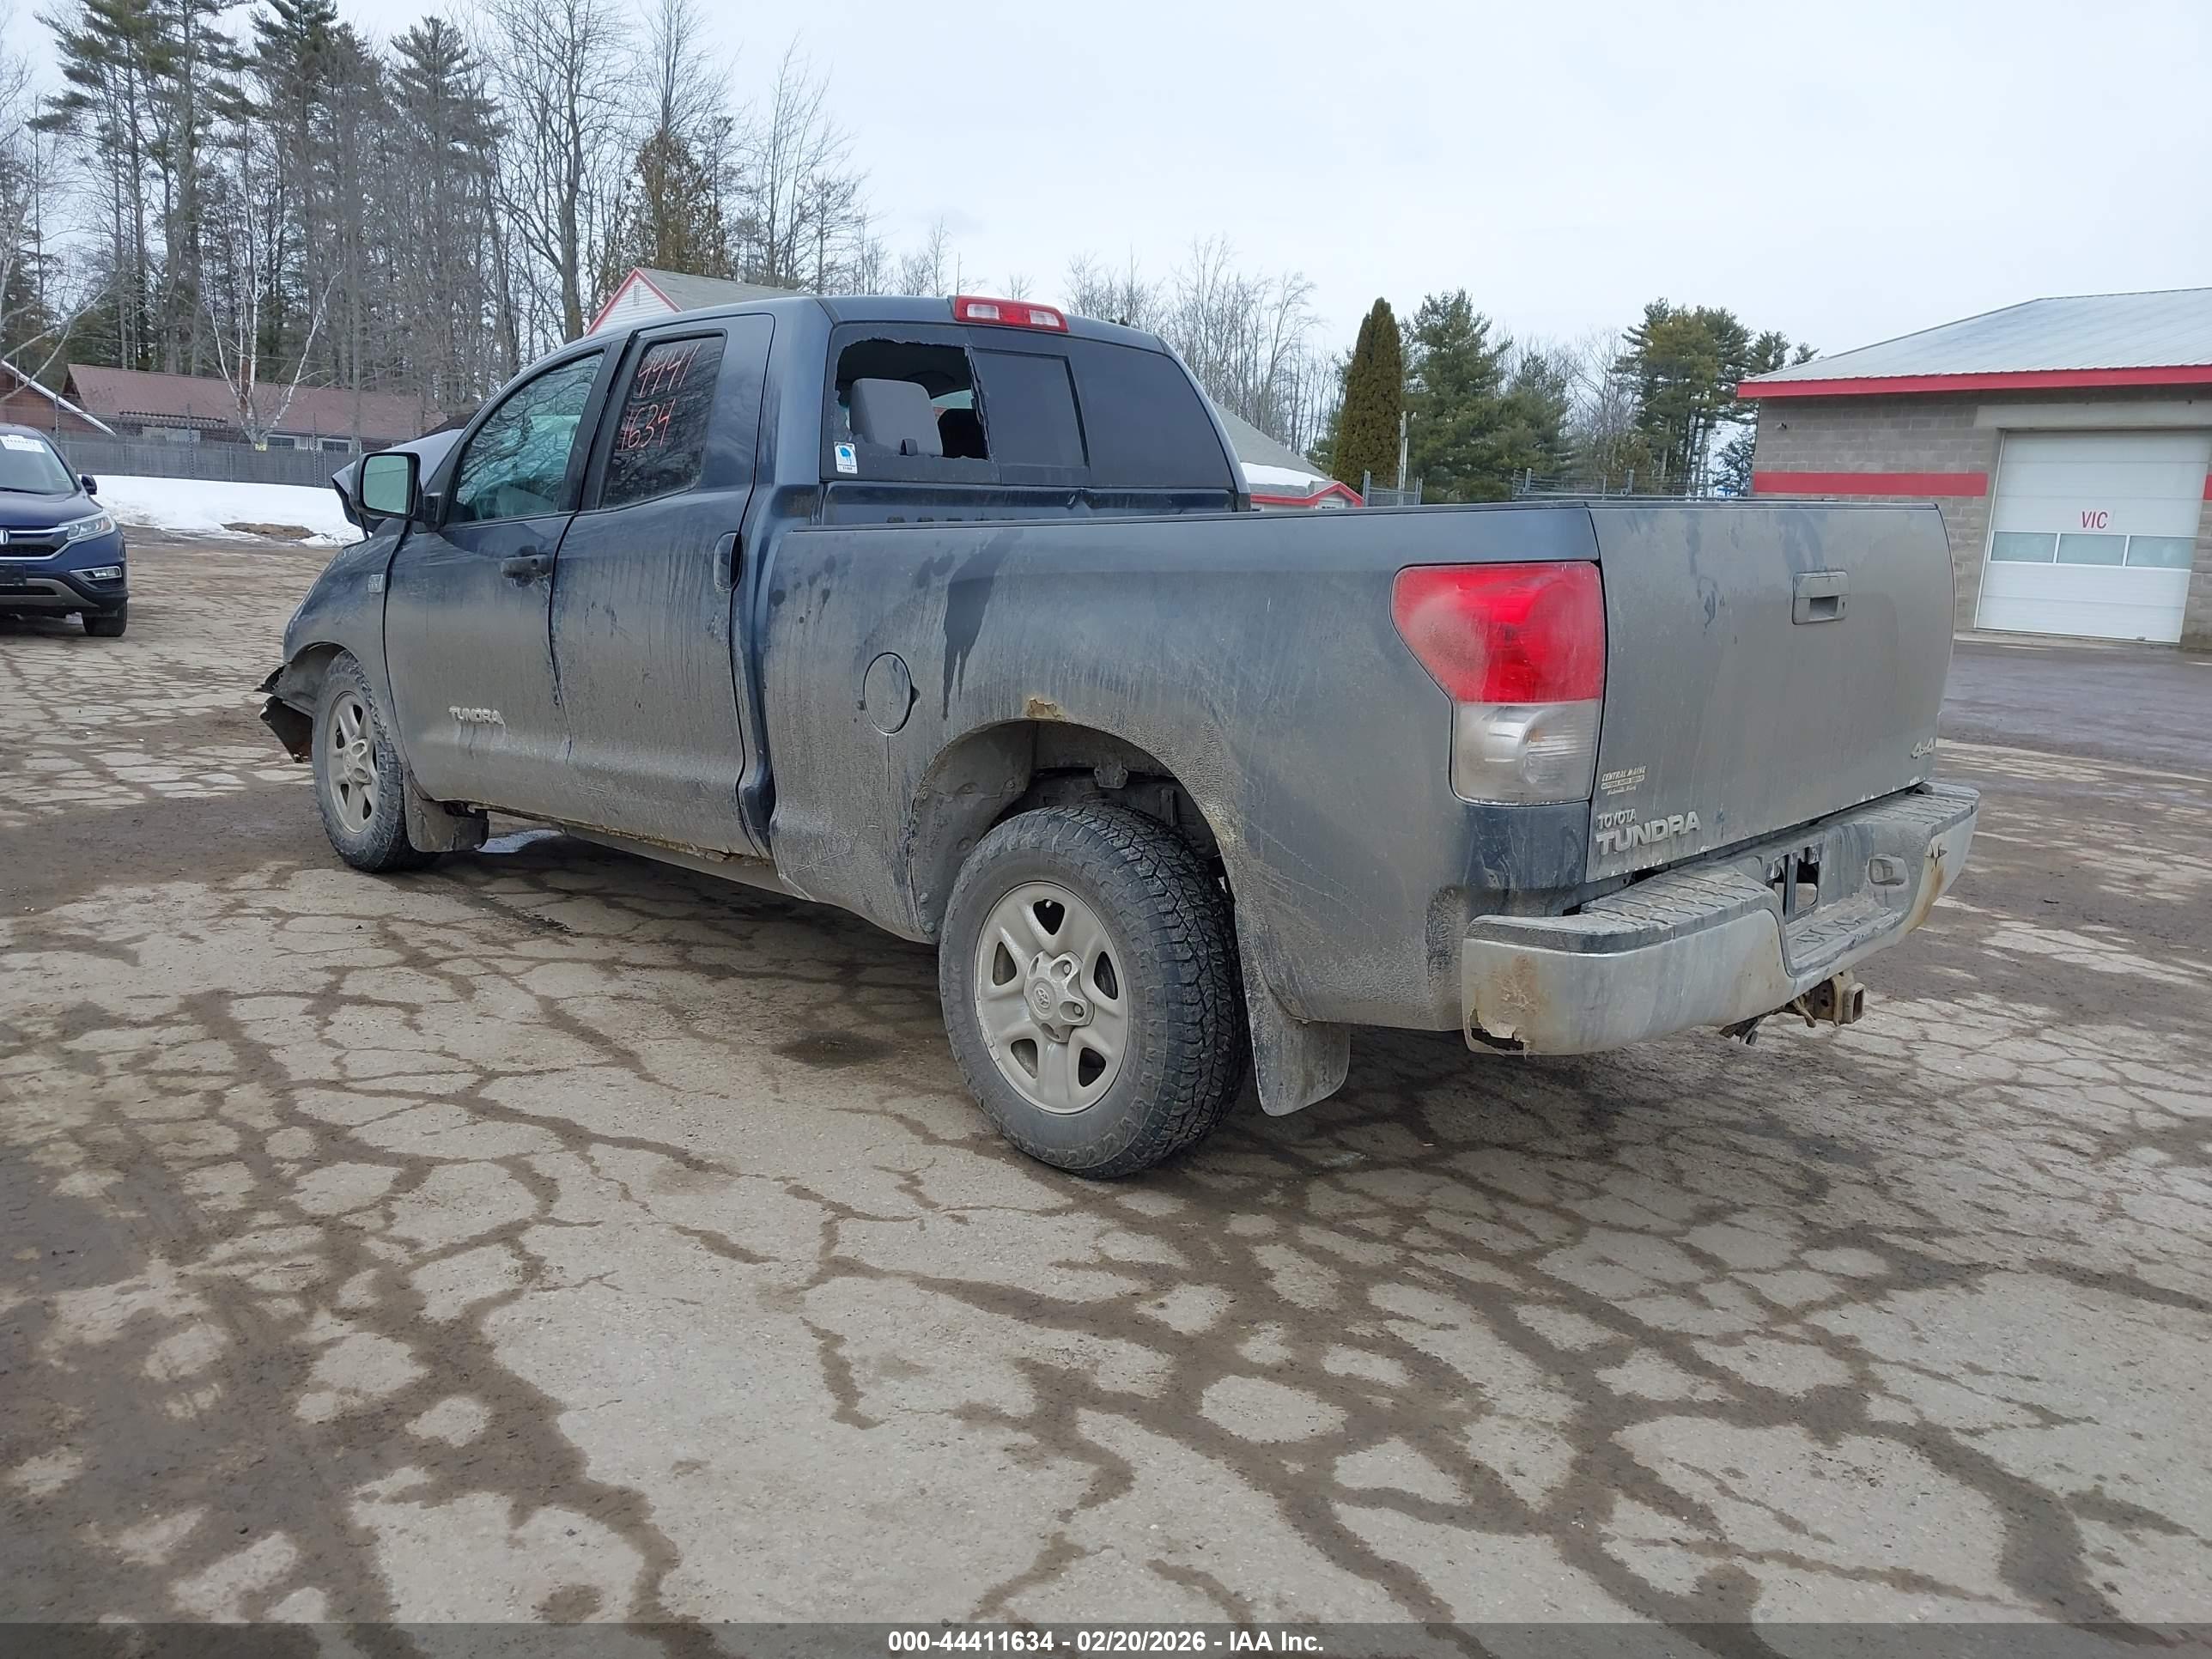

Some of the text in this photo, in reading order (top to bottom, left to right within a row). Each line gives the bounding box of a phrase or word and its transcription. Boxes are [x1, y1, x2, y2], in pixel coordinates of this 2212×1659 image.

[621, 398, 676, 450] 1634
[2081, 511, 2108, 529] VIC
[448, 706, 506, 727] TUNDRA
[1601, 769, 1626, 781] CENTRAL
[1597, 809, 1637, 830] TOYOTA
[1596, 811, 1702, 855] TUNDRA
